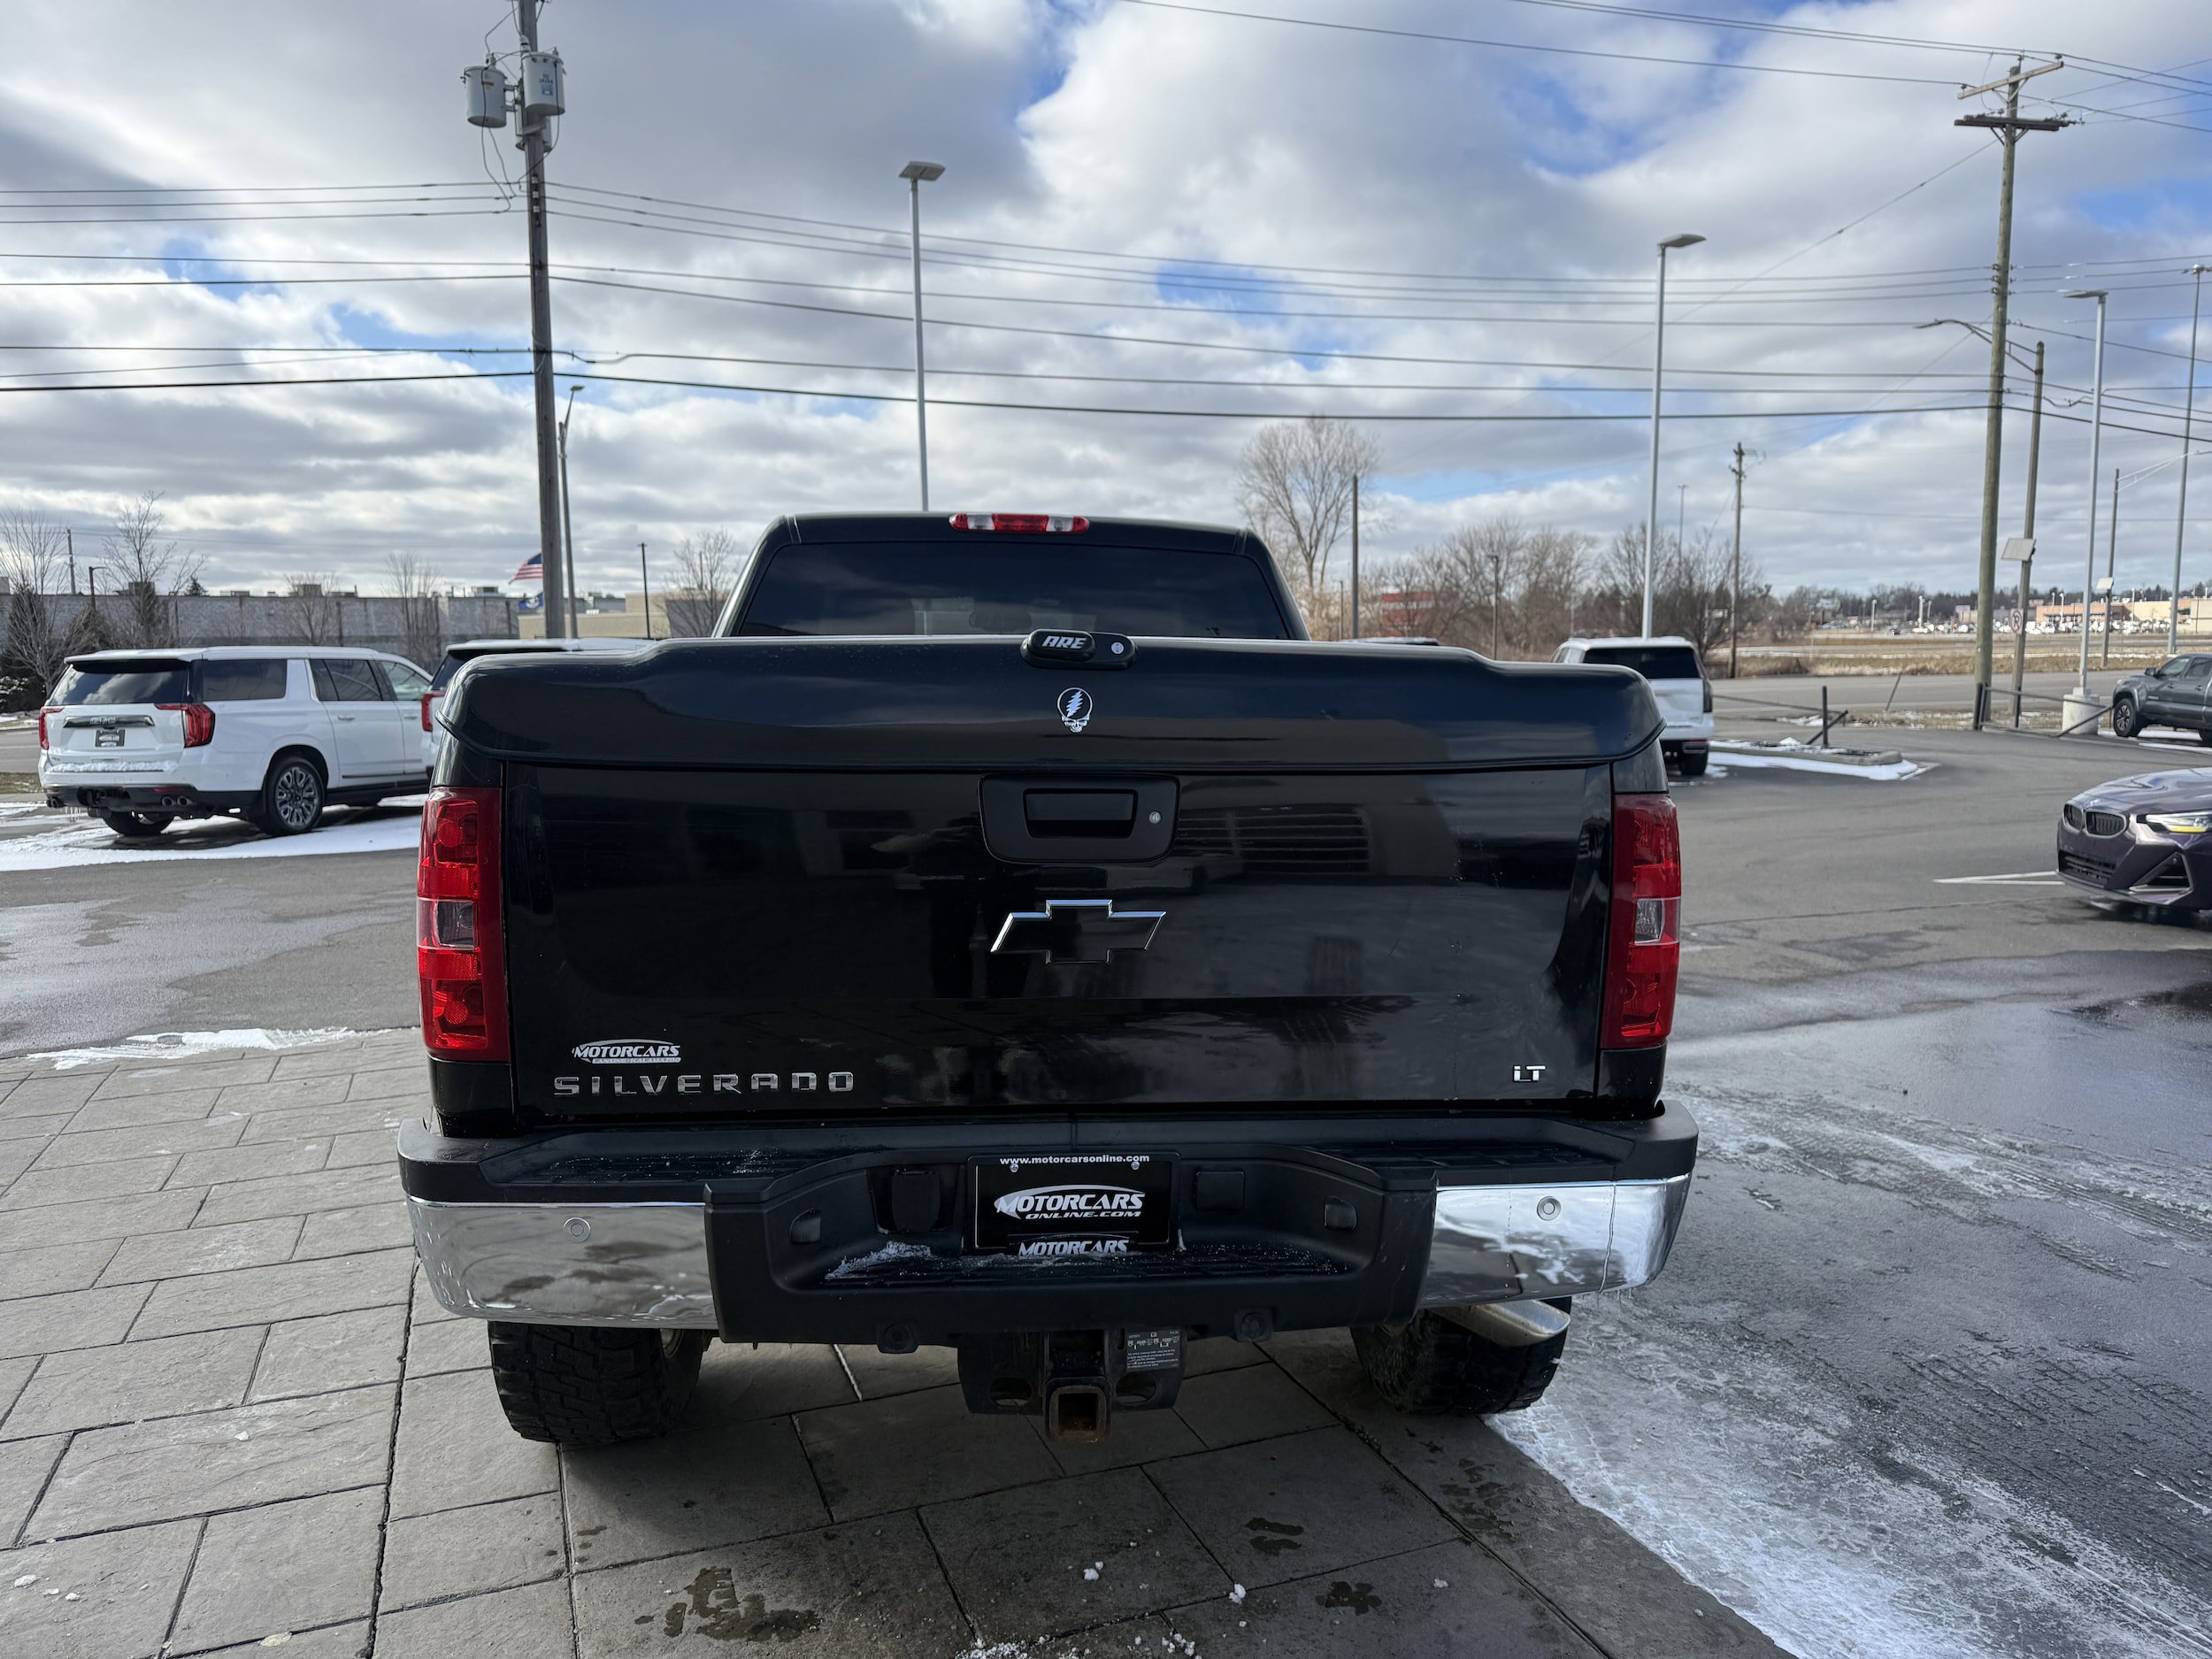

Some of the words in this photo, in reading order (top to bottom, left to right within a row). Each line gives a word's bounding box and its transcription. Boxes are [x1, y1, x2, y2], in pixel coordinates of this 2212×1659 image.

[1042, 636, 1087, 649] ARE
[574, 1045, 680, 1058] MOTORCARS
[1514, 1065, 1546, 1081] LT
[554, 1071, 854, 1095] SILVERADO
[1000, 1155, 1150, 1165] www.motorcarsonline.com
[996, 1194, 1146, 1213] MOTORCARS
[1025, 1211, 1142, 1220] ONLINE.COM
[1018, 1240, 1130, 1256] MOTORCARS
